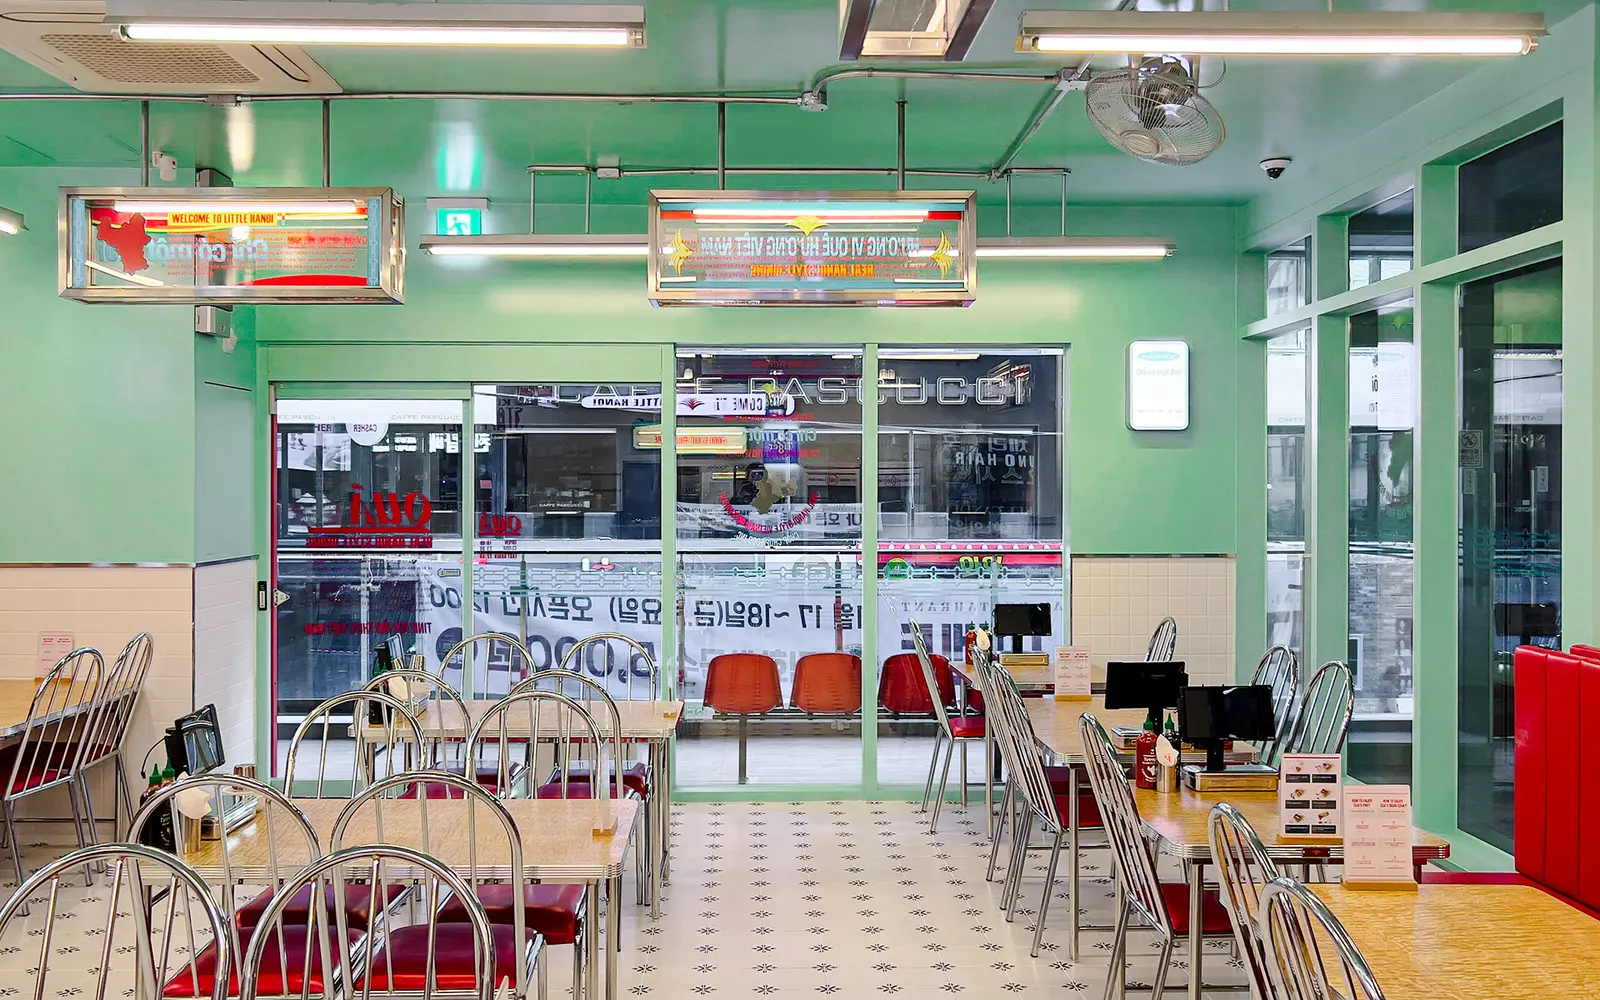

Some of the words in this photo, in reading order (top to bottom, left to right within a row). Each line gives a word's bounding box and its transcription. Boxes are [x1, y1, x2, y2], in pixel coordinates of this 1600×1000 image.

[172, 213, 210, 224] WELCOME
[212, 213, 222, 224] TO
[223, 213, 248, 224] LITTLE
[250, 213, 274, 224] HANOI
[747, 376, 1026, 405] PASCUCCI
